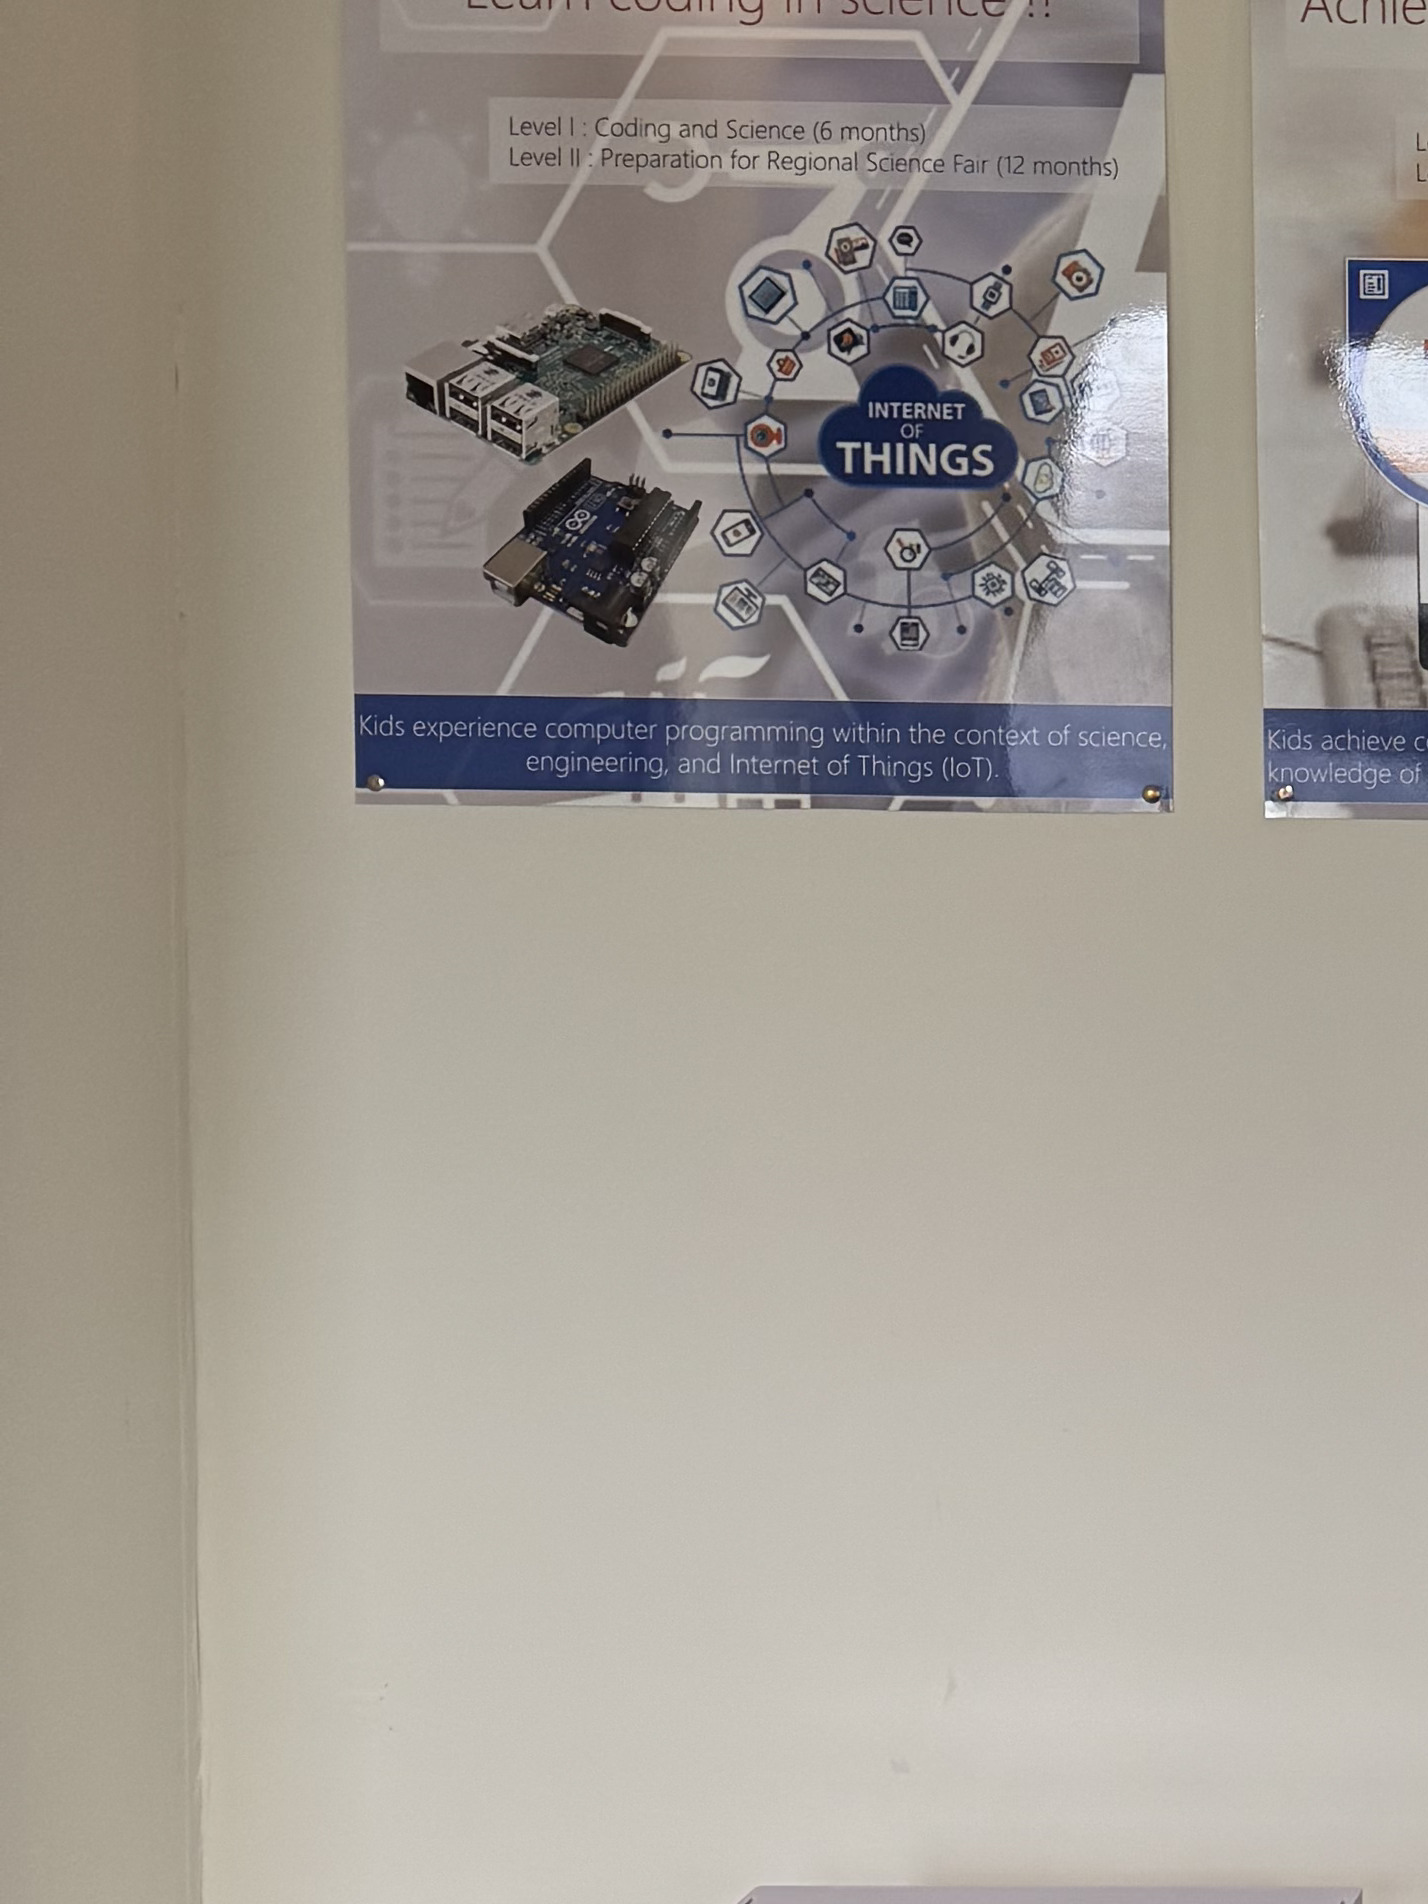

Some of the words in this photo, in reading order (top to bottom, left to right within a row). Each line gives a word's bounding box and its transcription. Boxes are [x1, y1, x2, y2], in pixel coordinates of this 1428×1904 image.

[509, 115, 562, 137] Level
[570, 116, 574, 137] I
[594, 116, 671, 144] Coding
[678, 118, 718, 140] and
[726, 118, 806, 141] Science
[812, 120, 833, 145] (6
[840, 121, 926, 146] months)
[868, 401, 966, 421] INTERNET
[899, 423, 923, 439] OF
[835, 442, 995, 477] THINGS
[359, 714, 406, 737] Kids
[412, 716, 538, 743] experience
[544, 720, 658, 745] computer
[665, 720, 825, 749] programming
[832, 721, 901, 744] within
[908, 722, 946, 745] the
[953, 725, 1040, 746] context
[1047, 723, 1071, 747] of
[1078, 730, 1167, 750] science,
[1268, 728, 1313, 751] Kids
[1320, 728, 1407, 752] achieve
[1268, 761, 1392, 791] knowledge
[1399, 762, 1422, 785] of
